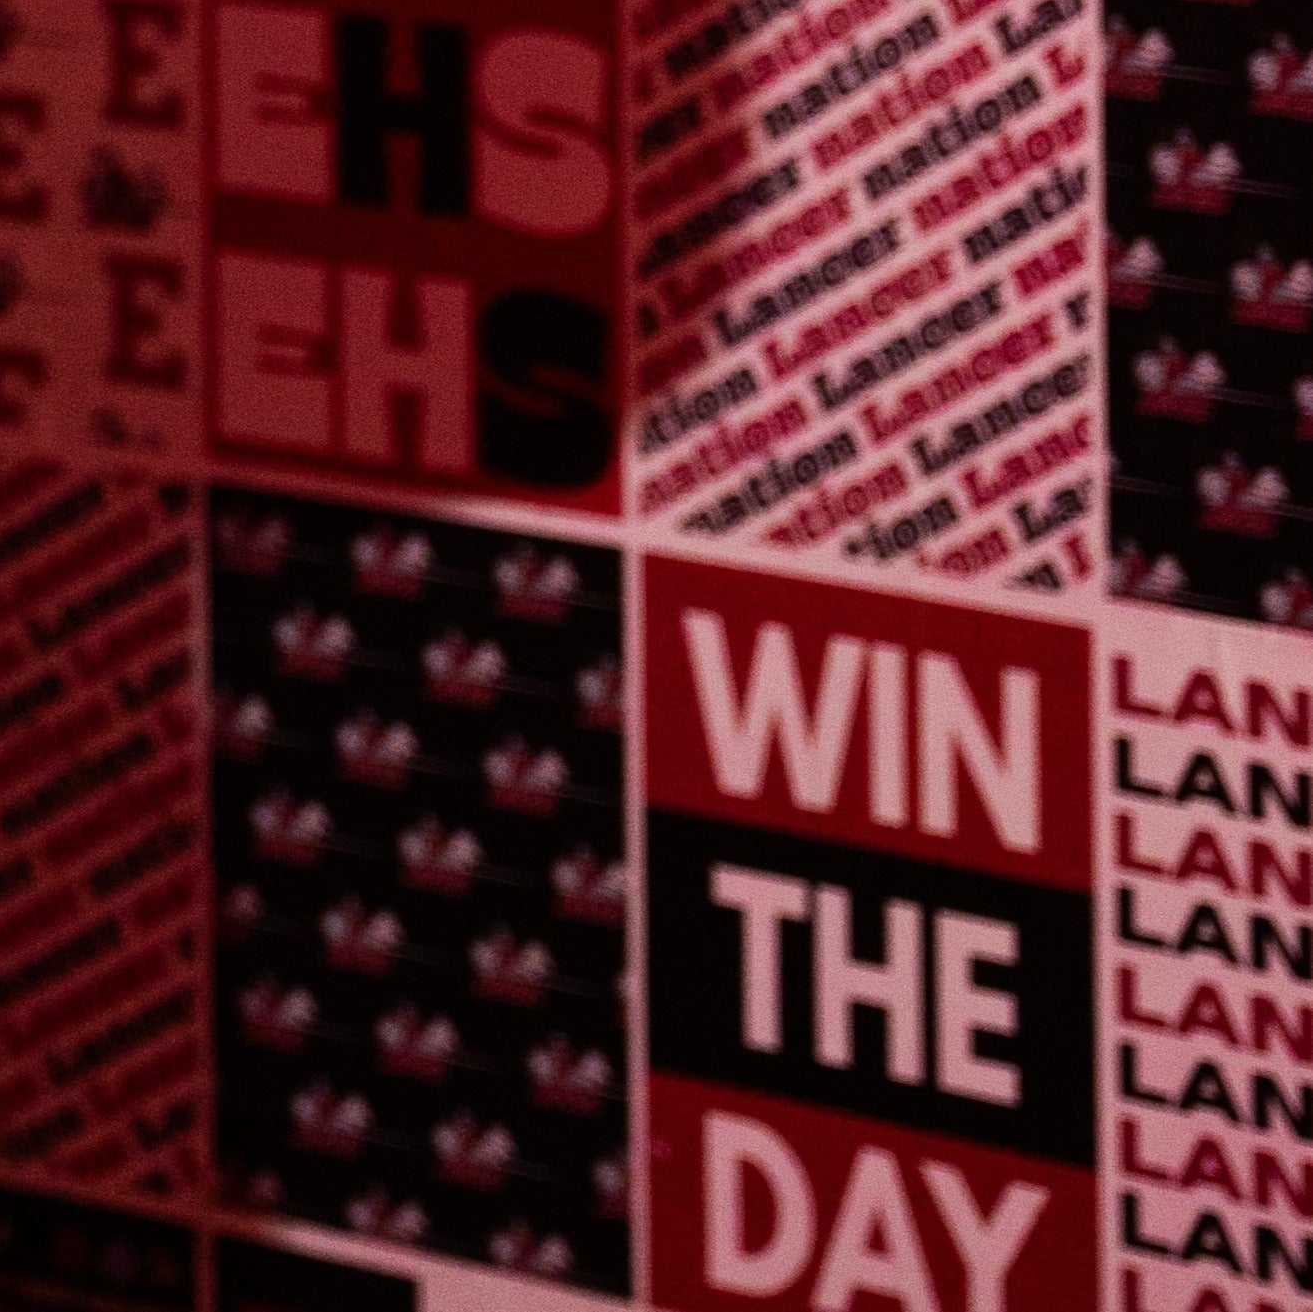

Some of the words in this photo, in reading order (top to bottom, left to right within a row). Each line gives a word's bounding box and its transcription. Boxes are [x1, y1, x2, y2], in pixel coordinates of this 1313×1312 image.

[215, 2, 613, 238] EHS
[758, 11, 942, 142] nation
[806, 39, 996, 175] nation
[860, 72, 1045, 203] nation
[706, 217, 901, 351] Lancer
[759, 246, 954, 388] Lancer
[810, 279, 1004, 414] Lancer
[215, 248, 614, 491] EHS
[856, 307, 1060, 451] Lancer
[908, 352, 1091, 478] Lance
[680, 606, 1042, 855] WIN
[708, 861, 1022, 1109] THE
[703, 1108, 1052, 1312] DAY
